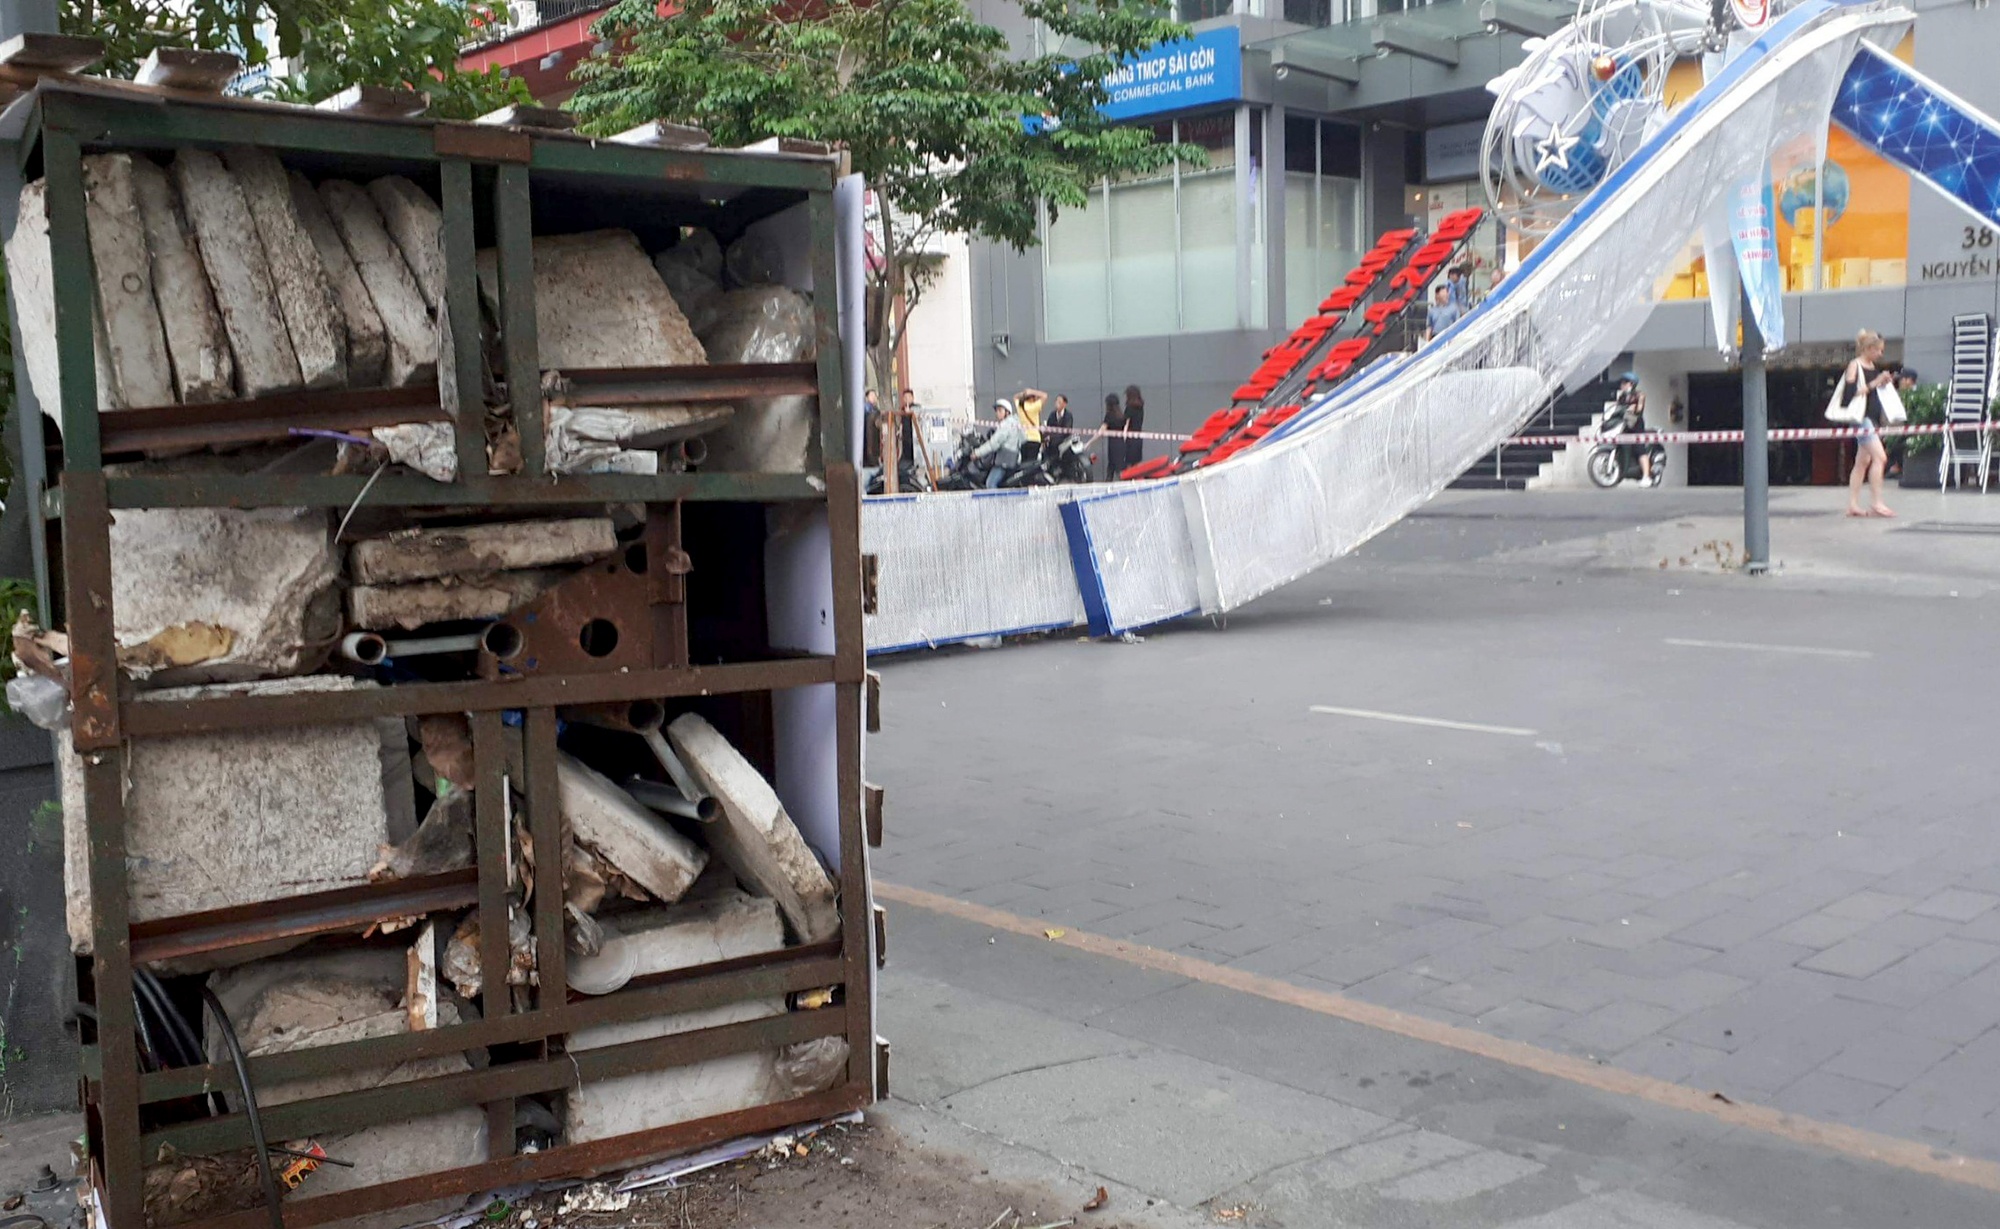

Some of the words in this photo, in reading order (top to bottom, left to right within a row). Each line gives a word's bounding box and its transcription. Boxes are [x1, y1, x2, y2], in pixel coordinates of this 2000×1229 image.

[1136, 57, 1166, 81] TMCP
[1168, 50, 1187, 76] SÀI
[1190, 45, 1215, 71] GÒN
[1114, 79, 1182, 103] COMMERCIAL
[1185, 71, 1215, 90] BANK
[1961, 225, 1993, 250] 38
